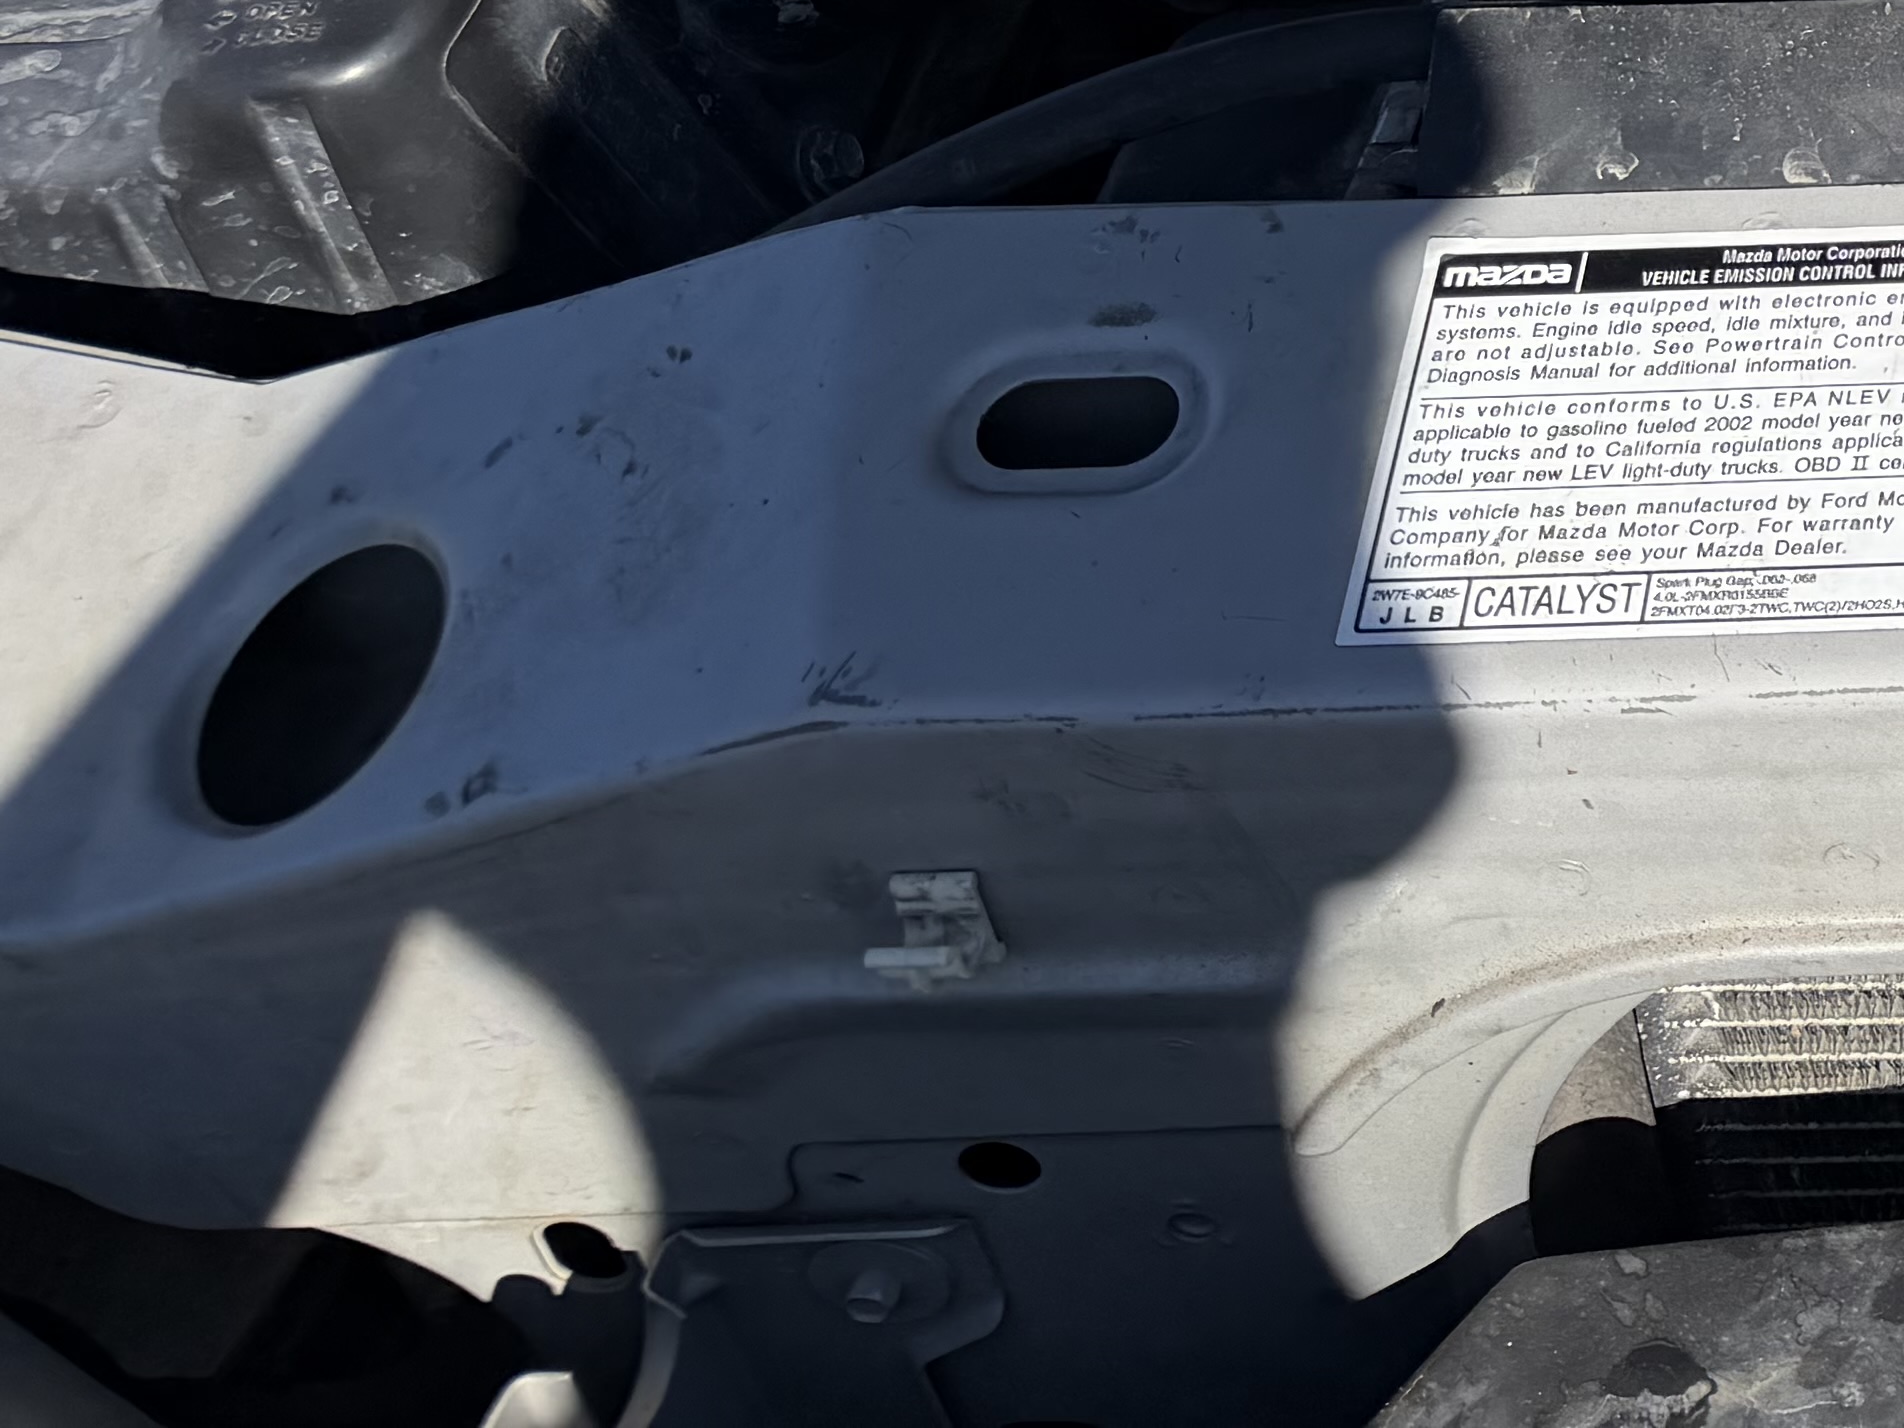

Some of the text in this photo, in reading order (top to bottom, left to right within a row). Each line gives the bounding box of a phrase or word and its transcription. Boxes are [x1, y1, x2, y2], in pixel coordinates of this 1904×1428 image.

[244, 1, 321, 20] OPEN
[1722, 249, 1773, 264] Mazda
[1777, 247, 1823, 262] Motor
[1443, 263, 1572, 287] mazda
[1642, 269, 1710, 286] VEHICLE
[1713, 267, 1795, 284] EMISSION
[1799, 264, 1875, 281] CONTROL
[1444, 304, 1485, 319] This
[1498, 301, 1571, 317] vehicle
[1583, 301, 1599, 315] is
[1610, 297, 1709, 317] equipped
[1719, 295, 1760, 310] with
[1772, 291, 1876, 309] electronic
[1420, 404, 1464, 420] This
[1478, 401, 1556, 417] vehicle
[1567, 398, 1670, 414] conforms
[1683, 397, 1702, 411] to
[1714, 393, 1760, 410] U.S.
[1774, 391, 1817, 408] EPA
[1828, 389, 1891, 406] NLEV
[1515, 548, 1584, 568] please
[1595, 548, 1631, 561] see
[1640, 547, 1687, 564] your
[1697, 541, 1763, 558] Mazda
[1775, 539, 1846, 555] Dealer.
[1474, 583, 1642, 617] CATALYST
[1380, 606, 1444, 624] J L B
